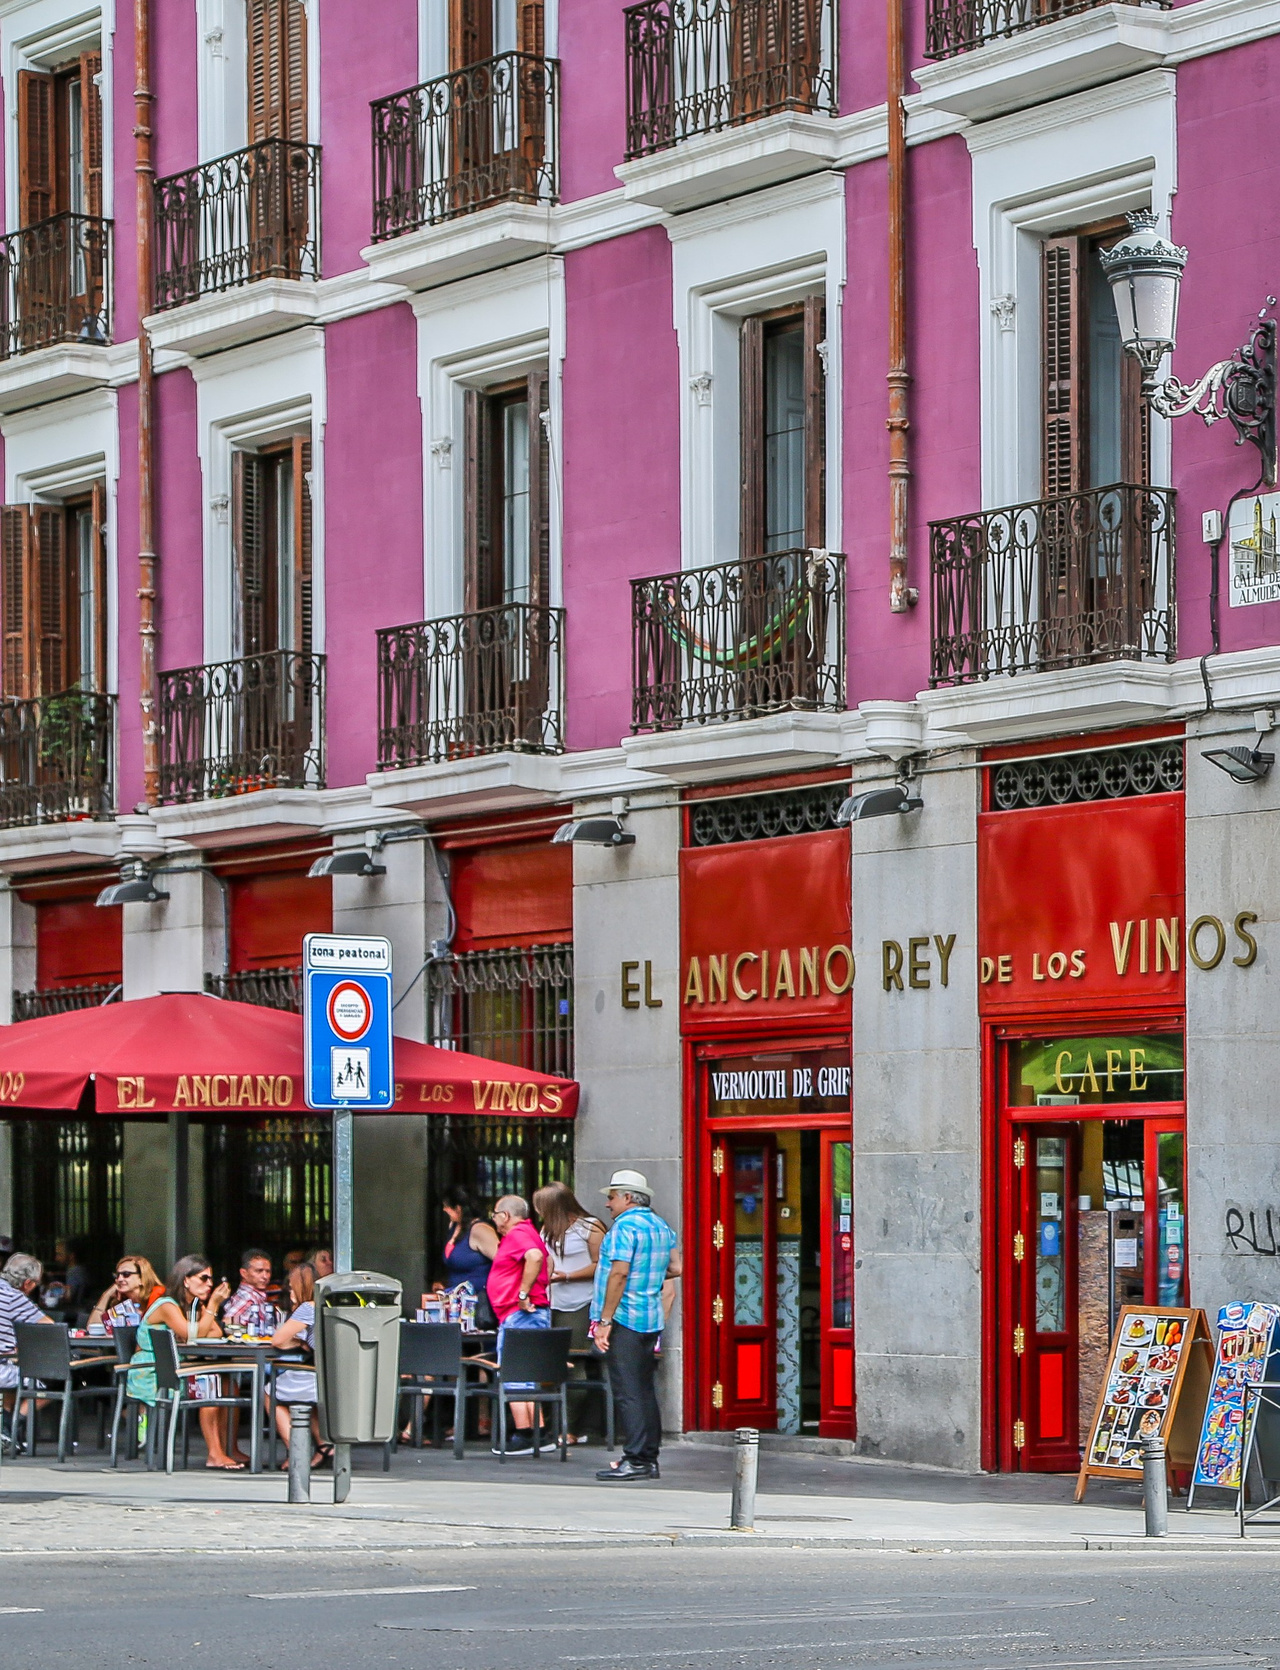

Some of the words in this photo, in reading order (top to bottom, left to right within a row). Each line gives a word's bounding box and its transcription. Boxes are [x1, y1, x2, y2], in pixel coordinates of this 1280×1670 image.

[1233, 572, 1265, 589] CALLE
[1269, 571, 1280, 584] DE
[312, 947, 335, 957] zona
[338, 946, 386, 960] peatonal
[621, 960, 663, 1009] EL
[683, 944, 856, 1005] ANCIANO
[882, 934, 957, 992] REY
[980, 955, 1013, 984] DE
[1032, 949, 1087, 981] LOS
[1109, 911, 1258, 975] VINOS
[0, 1071, 25, 1102] 09
[711, 1069, 787, 1101] VERMOUTH
[792, 1068, 813, 1098] DE
[1055, 1048, 1148, 1094] CAFE
[116, 1076, 157, 1109] EL
[171, 1074, 294, 1107] ANCIANO
[419, 1083, 454, 1102] LOS
[470, 1079, 564, 1113] VINOS
